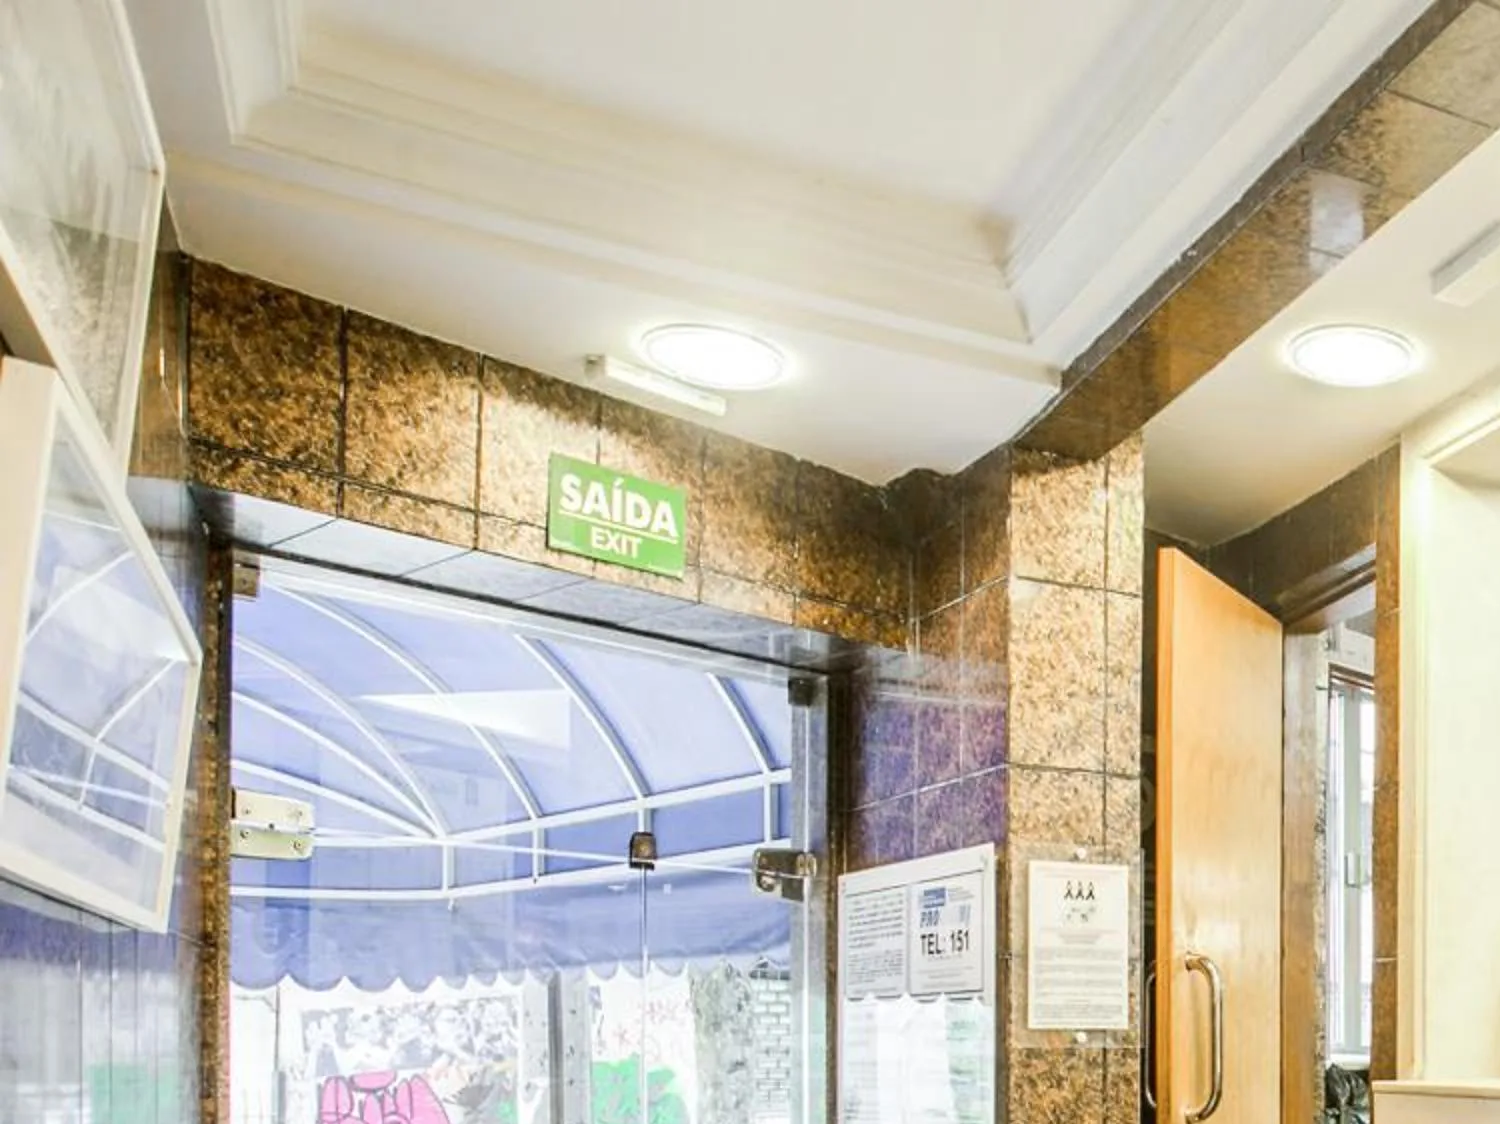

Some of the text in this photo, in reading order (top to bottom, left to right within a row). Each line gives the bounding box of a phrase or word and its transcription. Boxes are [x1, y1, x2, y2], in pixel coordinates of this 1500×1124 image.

[558, 472, 680, 538] SAÍDA
[590, 526, 643, 558] EXIT
[950, 928, 970, 953] 151
